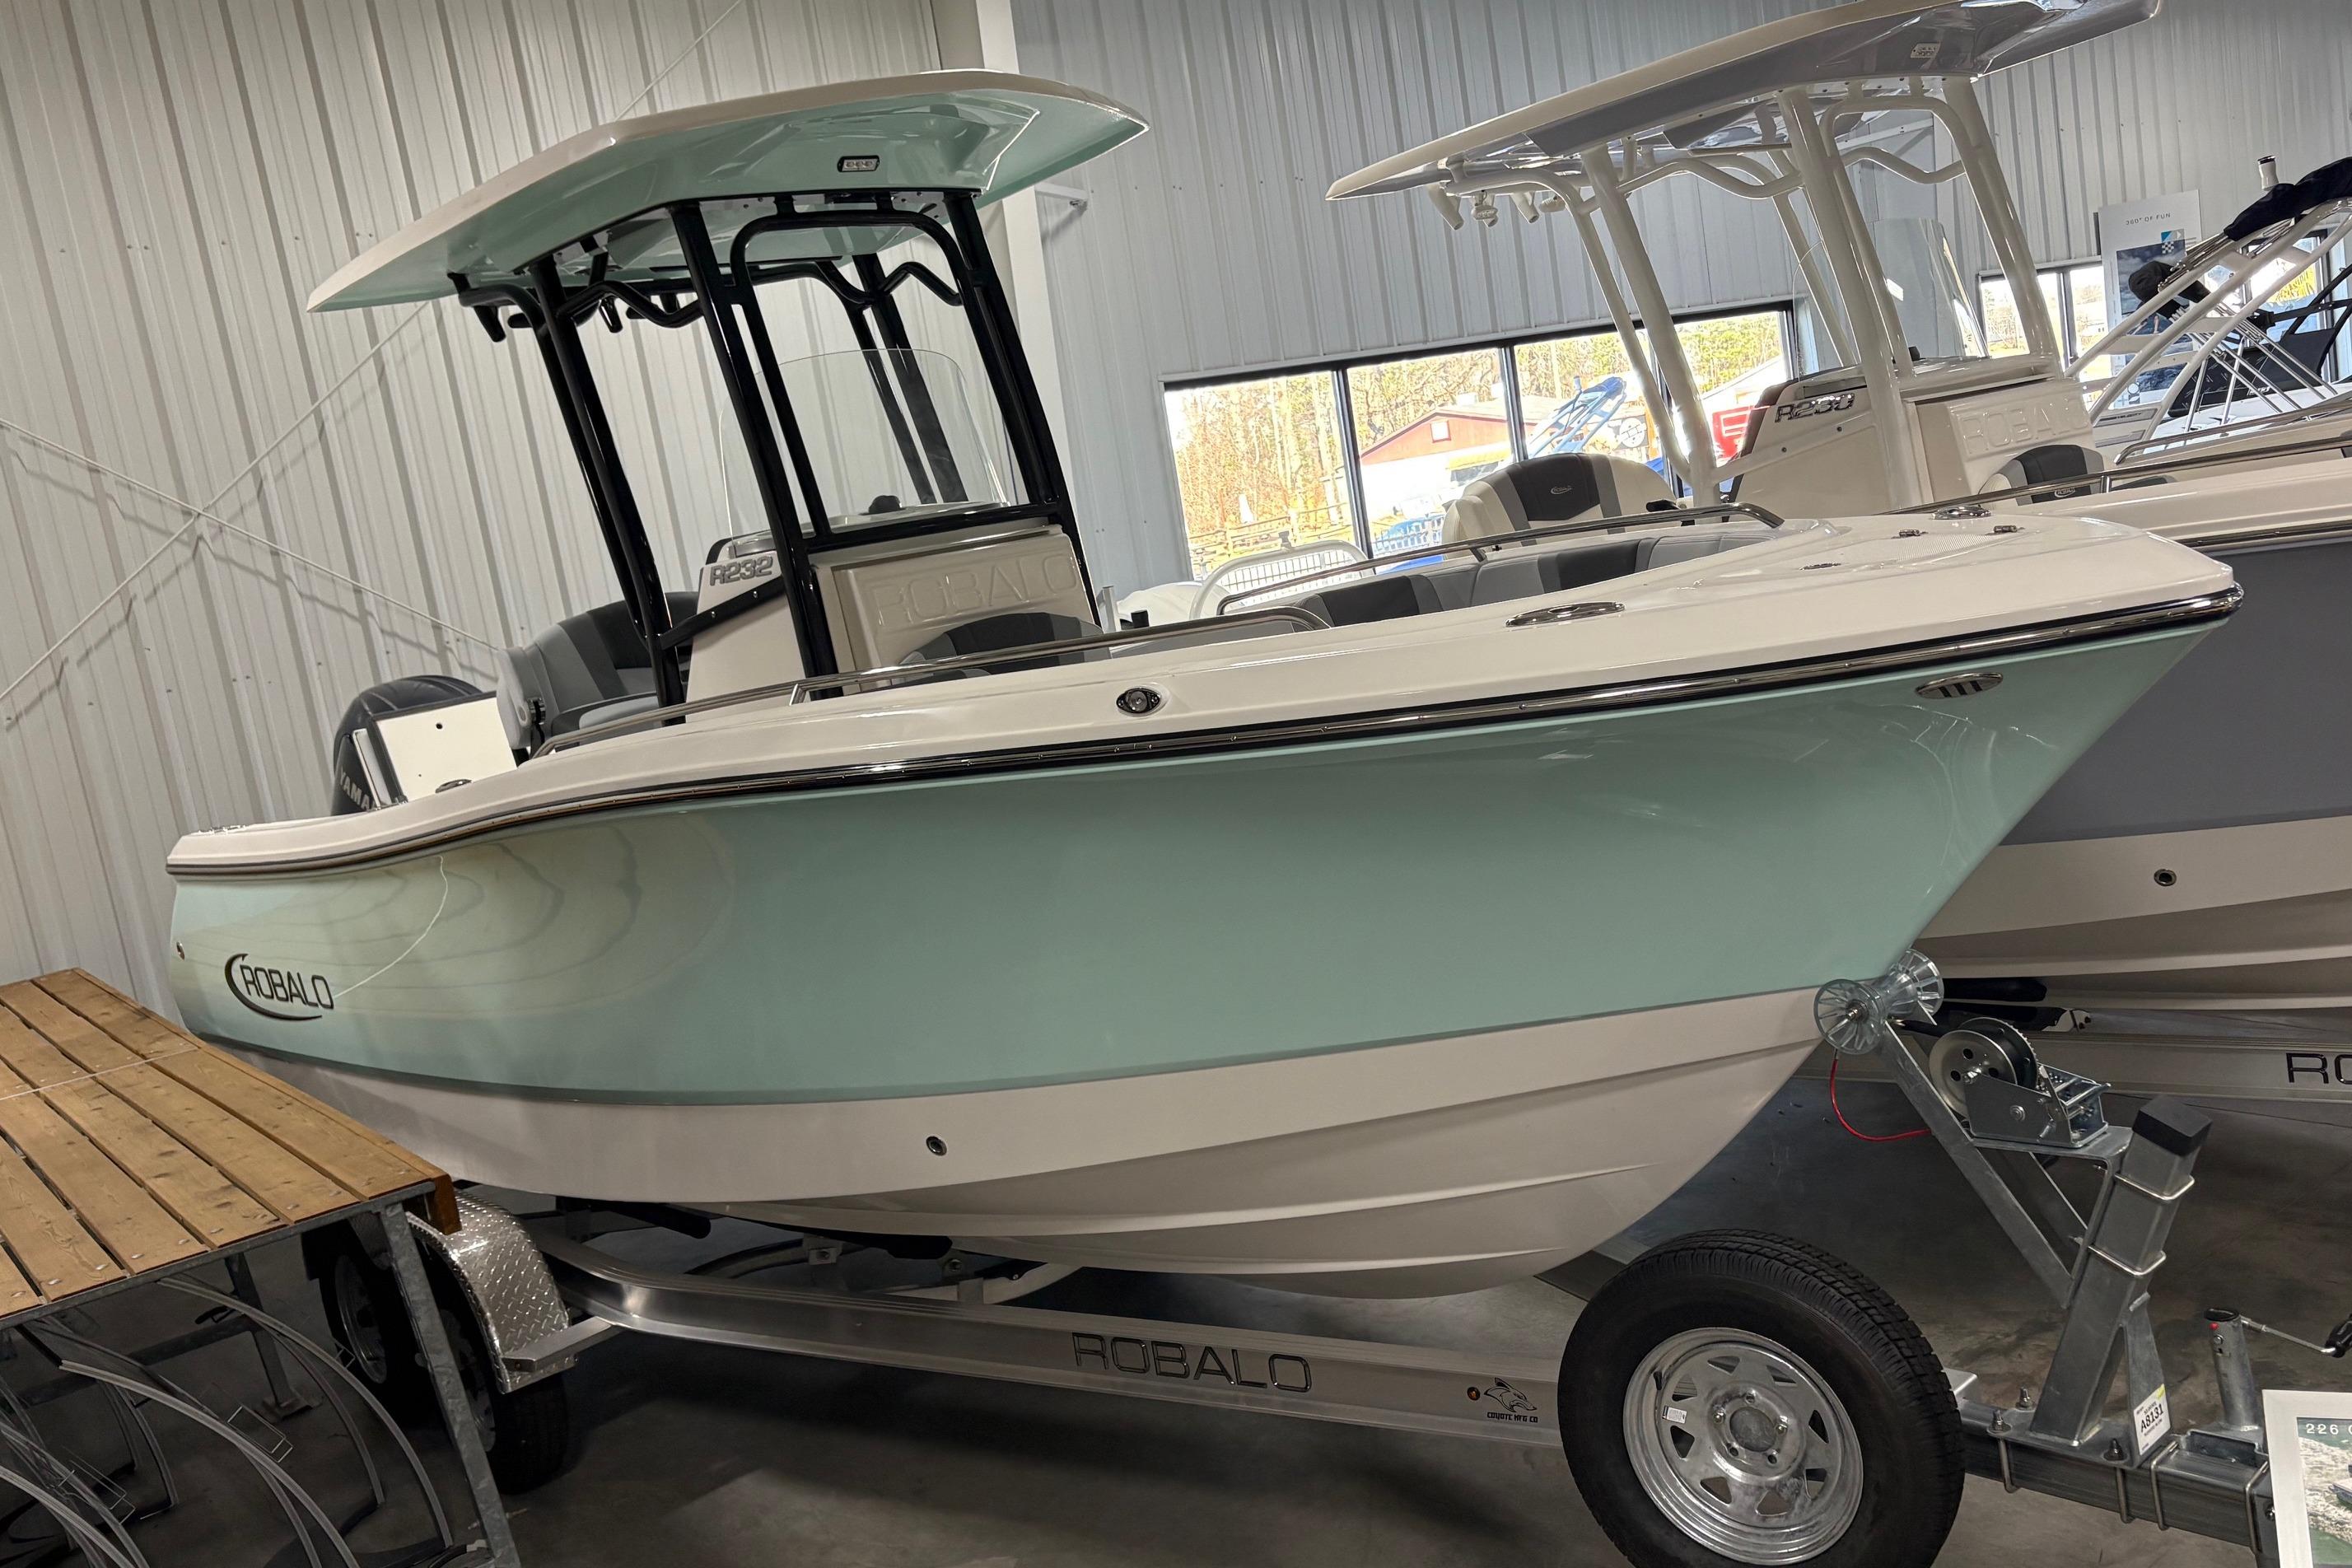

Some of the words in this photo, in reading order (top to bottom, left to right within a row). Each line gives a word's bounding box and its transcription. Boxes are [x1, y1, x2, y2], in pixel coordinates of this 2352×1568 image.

[710, 556, 772, 586] R232
[870, 553, 1079, 625] ROBALO
[240, 964, 334, 1010] ROBALO
[1072, 1332, 1312, 1393] ROBALO
[1487, 1412, 1514, 1421] COYOTE
[2141, 1403, 2163, 1433] A8131
[2305, 1423, 2339, 1435] 226
